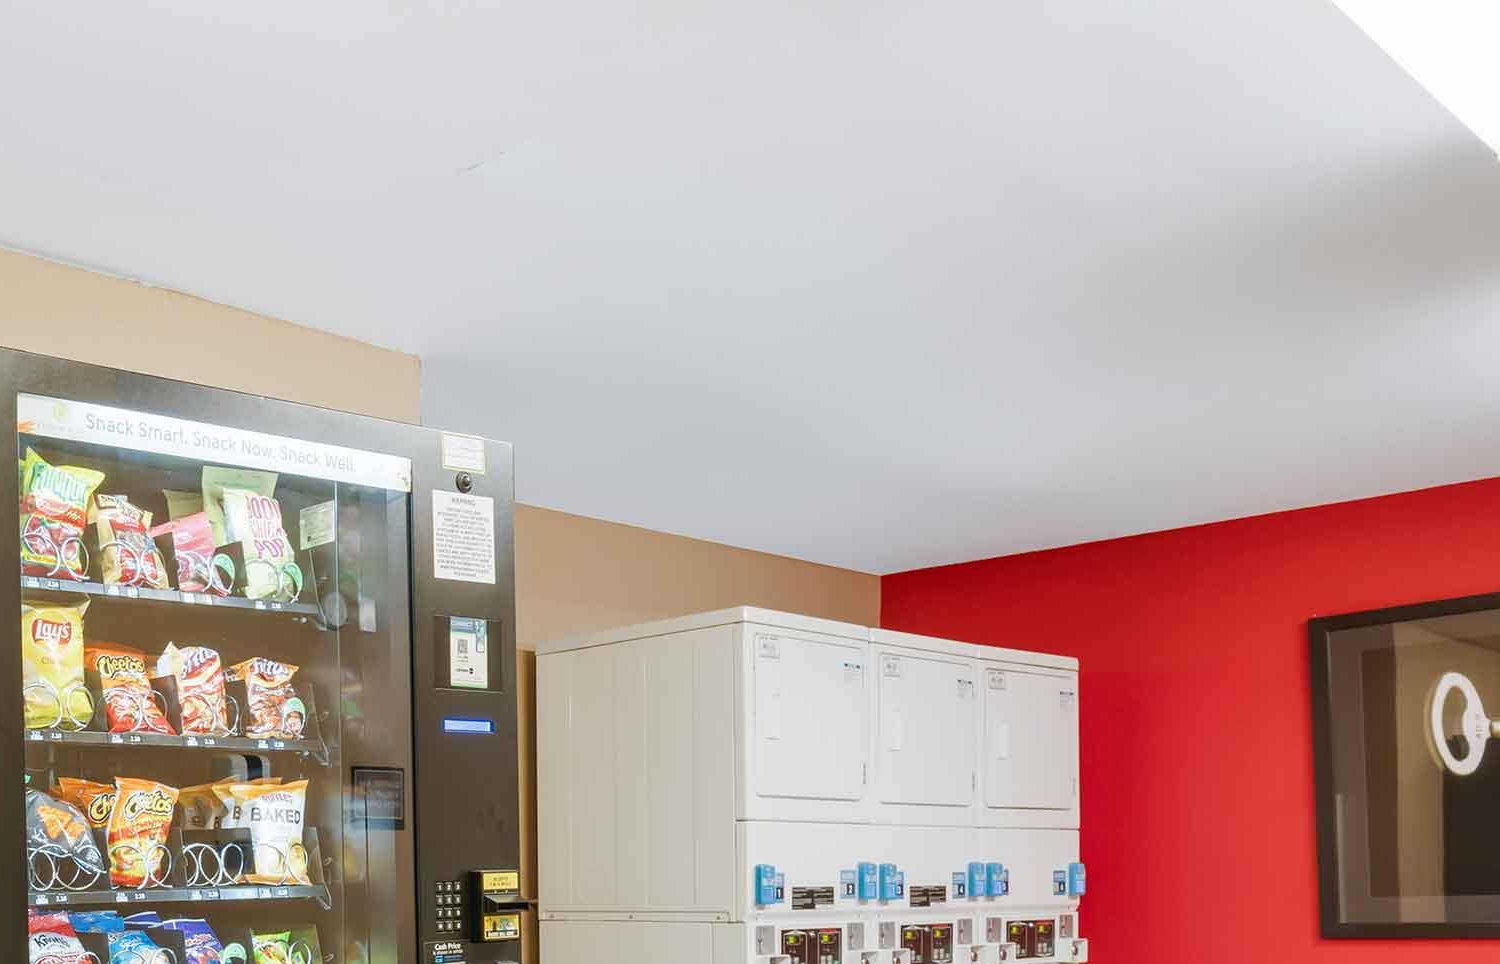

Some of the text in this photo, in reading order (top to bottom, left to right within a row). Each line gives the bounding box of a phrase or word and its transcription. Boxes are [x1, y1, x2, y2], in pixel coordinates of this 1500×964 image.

[85, 414, 356, 472] Snack Smart. Snack Now. Snack Well.
[36, 619, 71, 643] Lay's
[96, 656, 145, 679] Cheetos
[124, 790, 173, 820] Cheetos
[251, 807, 301, 824] BAKED
[435, 942, 461, 951] Cash Price
